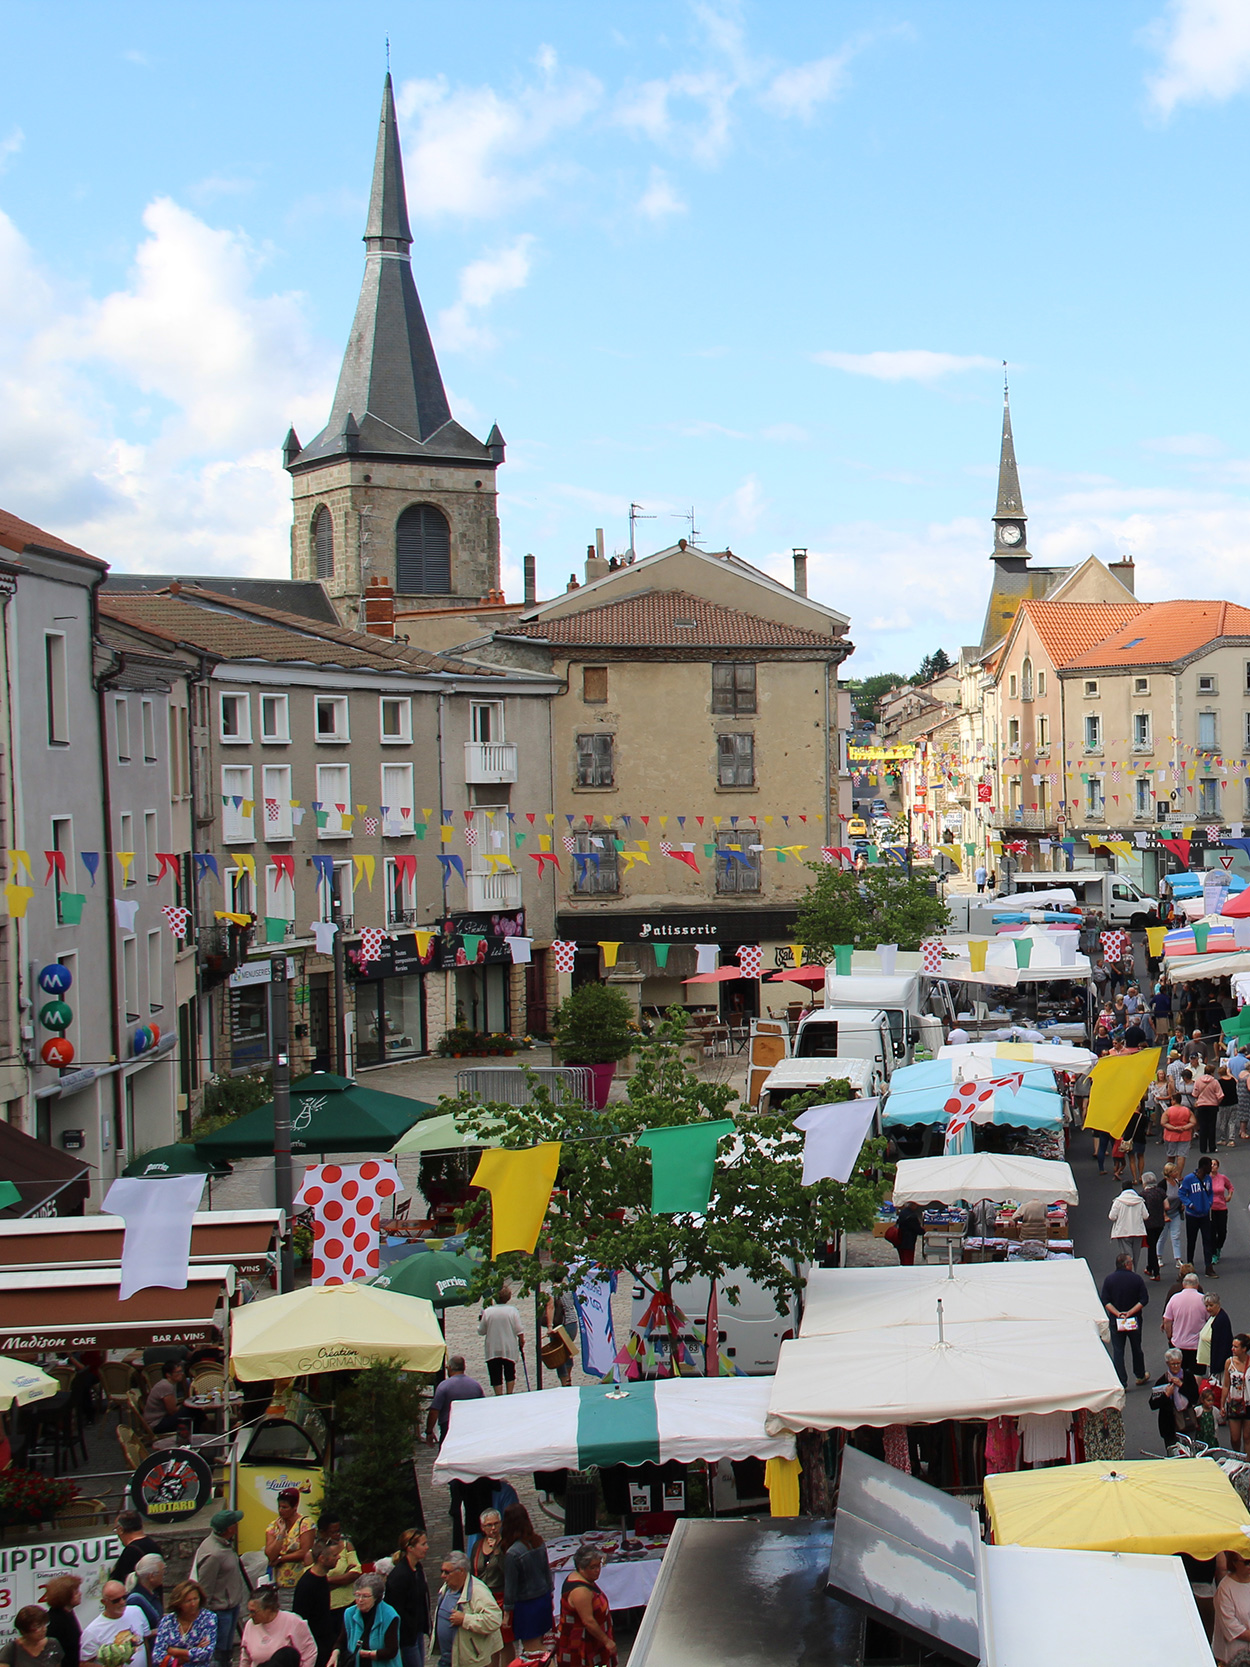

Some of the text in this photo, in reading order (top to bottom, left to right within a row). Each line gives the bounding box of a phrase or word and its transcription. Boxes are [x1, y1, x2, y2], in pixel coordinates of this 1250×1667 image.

[639, 923, 717, 938] Patisserie
[240, 1264, 261, 1273] VINS
[1, 1332, 206, 1350] Madison CAFE BAR A VINS
[317, 1347, 360, 1359] Création
[148, 1500, 195, 1514] MOTARD
